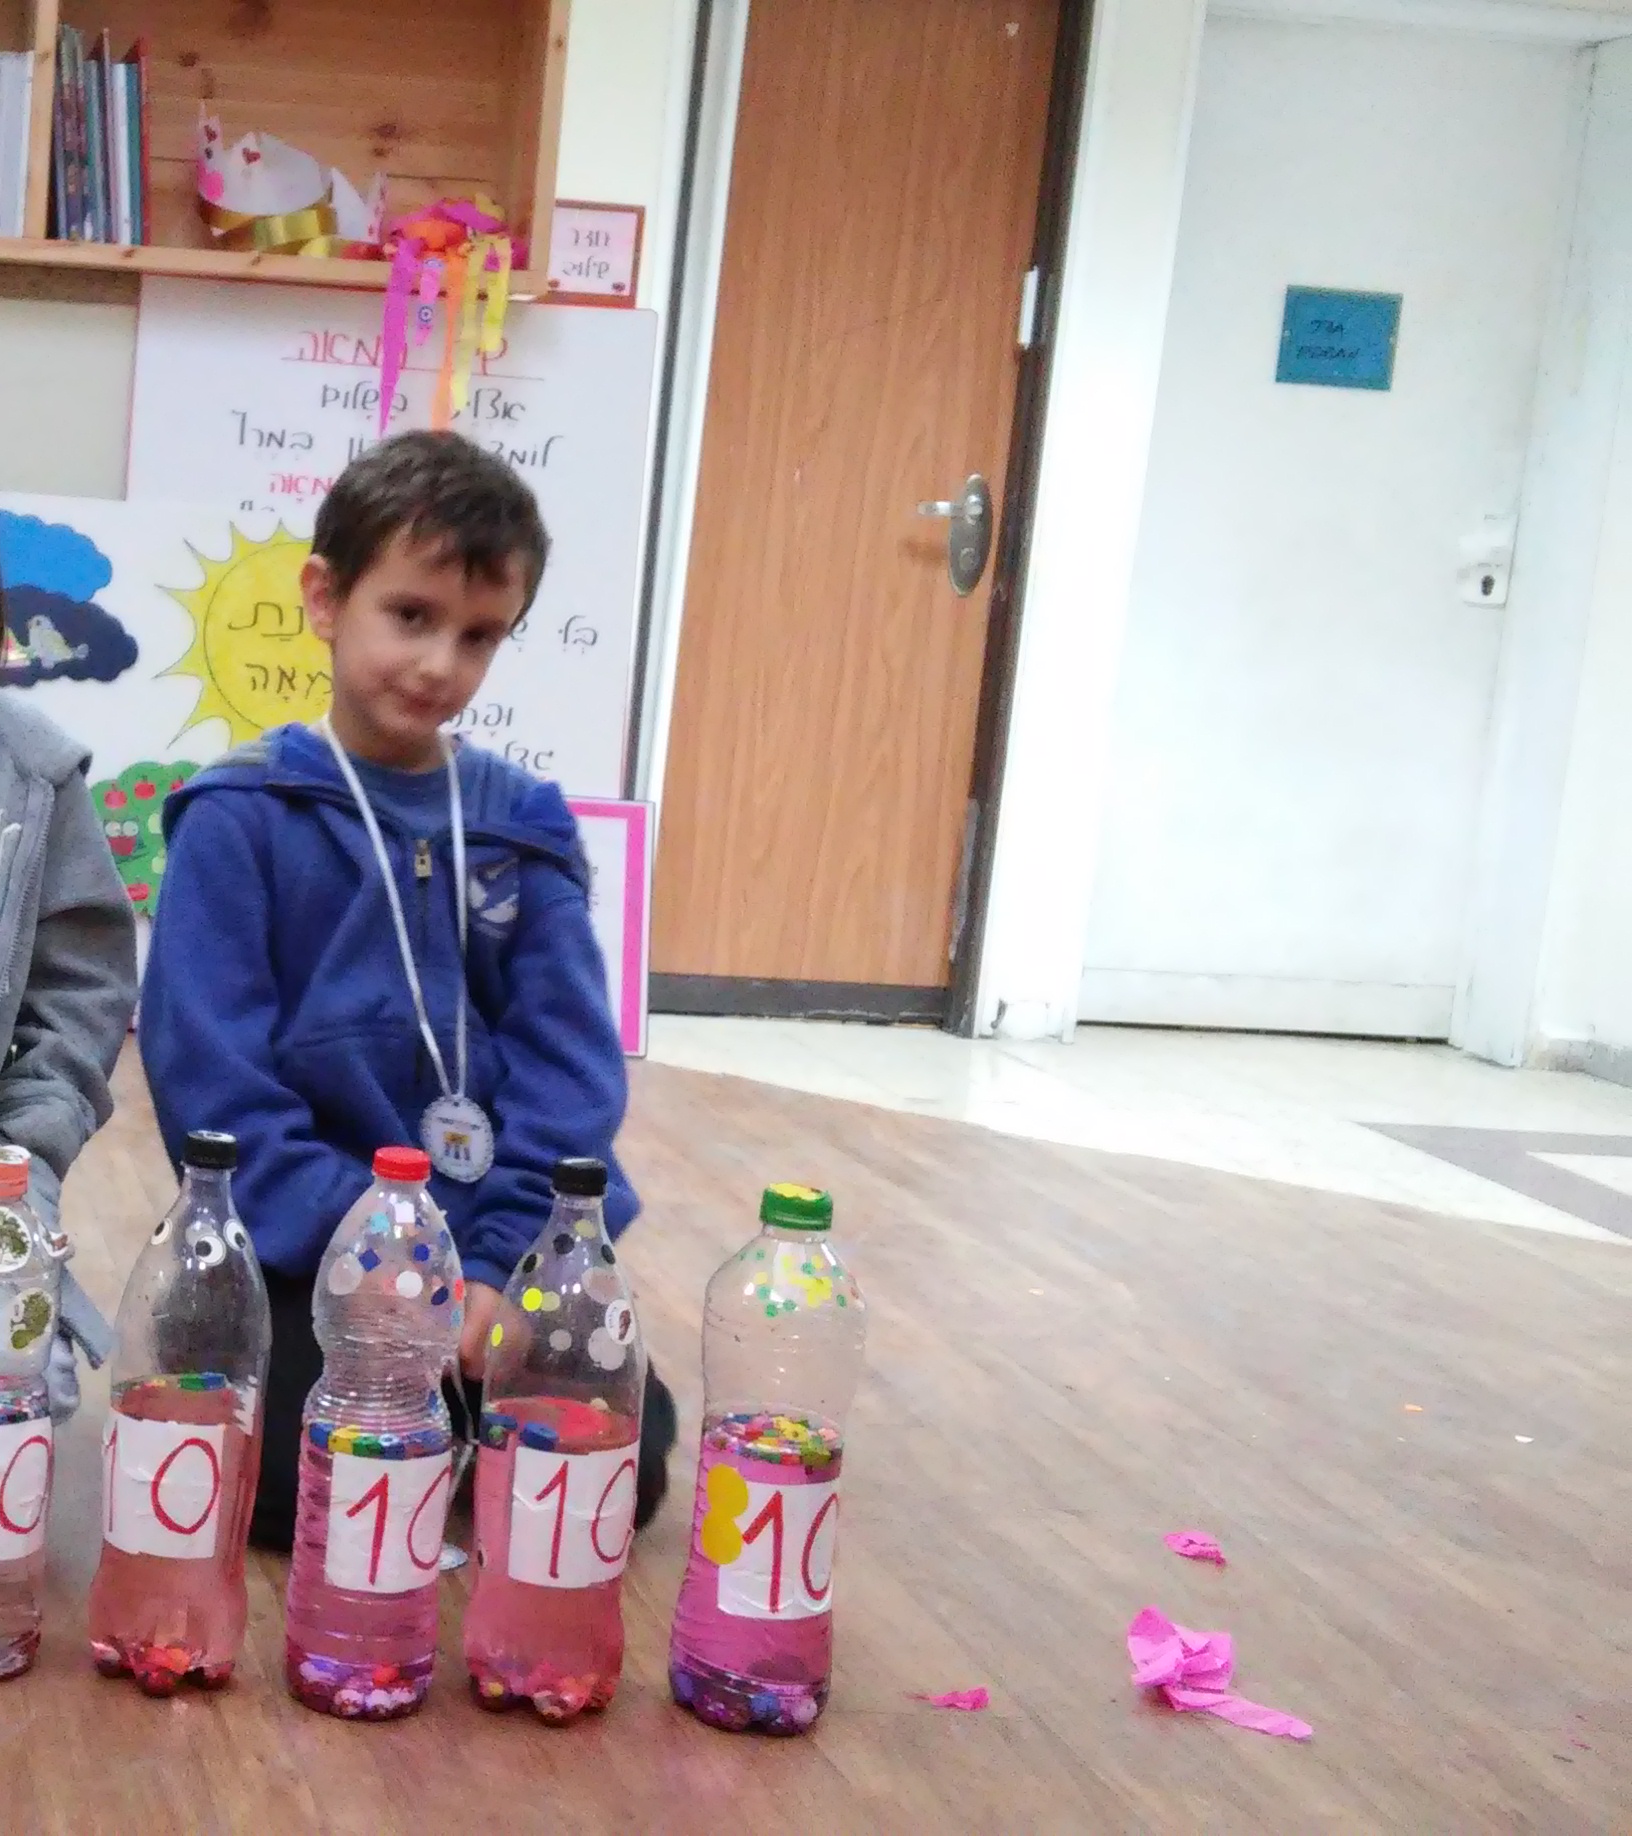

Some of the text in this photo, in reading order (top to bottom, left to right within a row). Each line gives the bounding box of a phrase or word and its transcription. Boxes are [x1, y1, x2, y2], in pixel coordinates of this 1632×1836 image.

[104, 1420, 221, 1535] 10
[346, 1465, 453, 1586] 10
[535, 1458, 636, 1580] 10
[742, 1490, 839, 1614] 10
